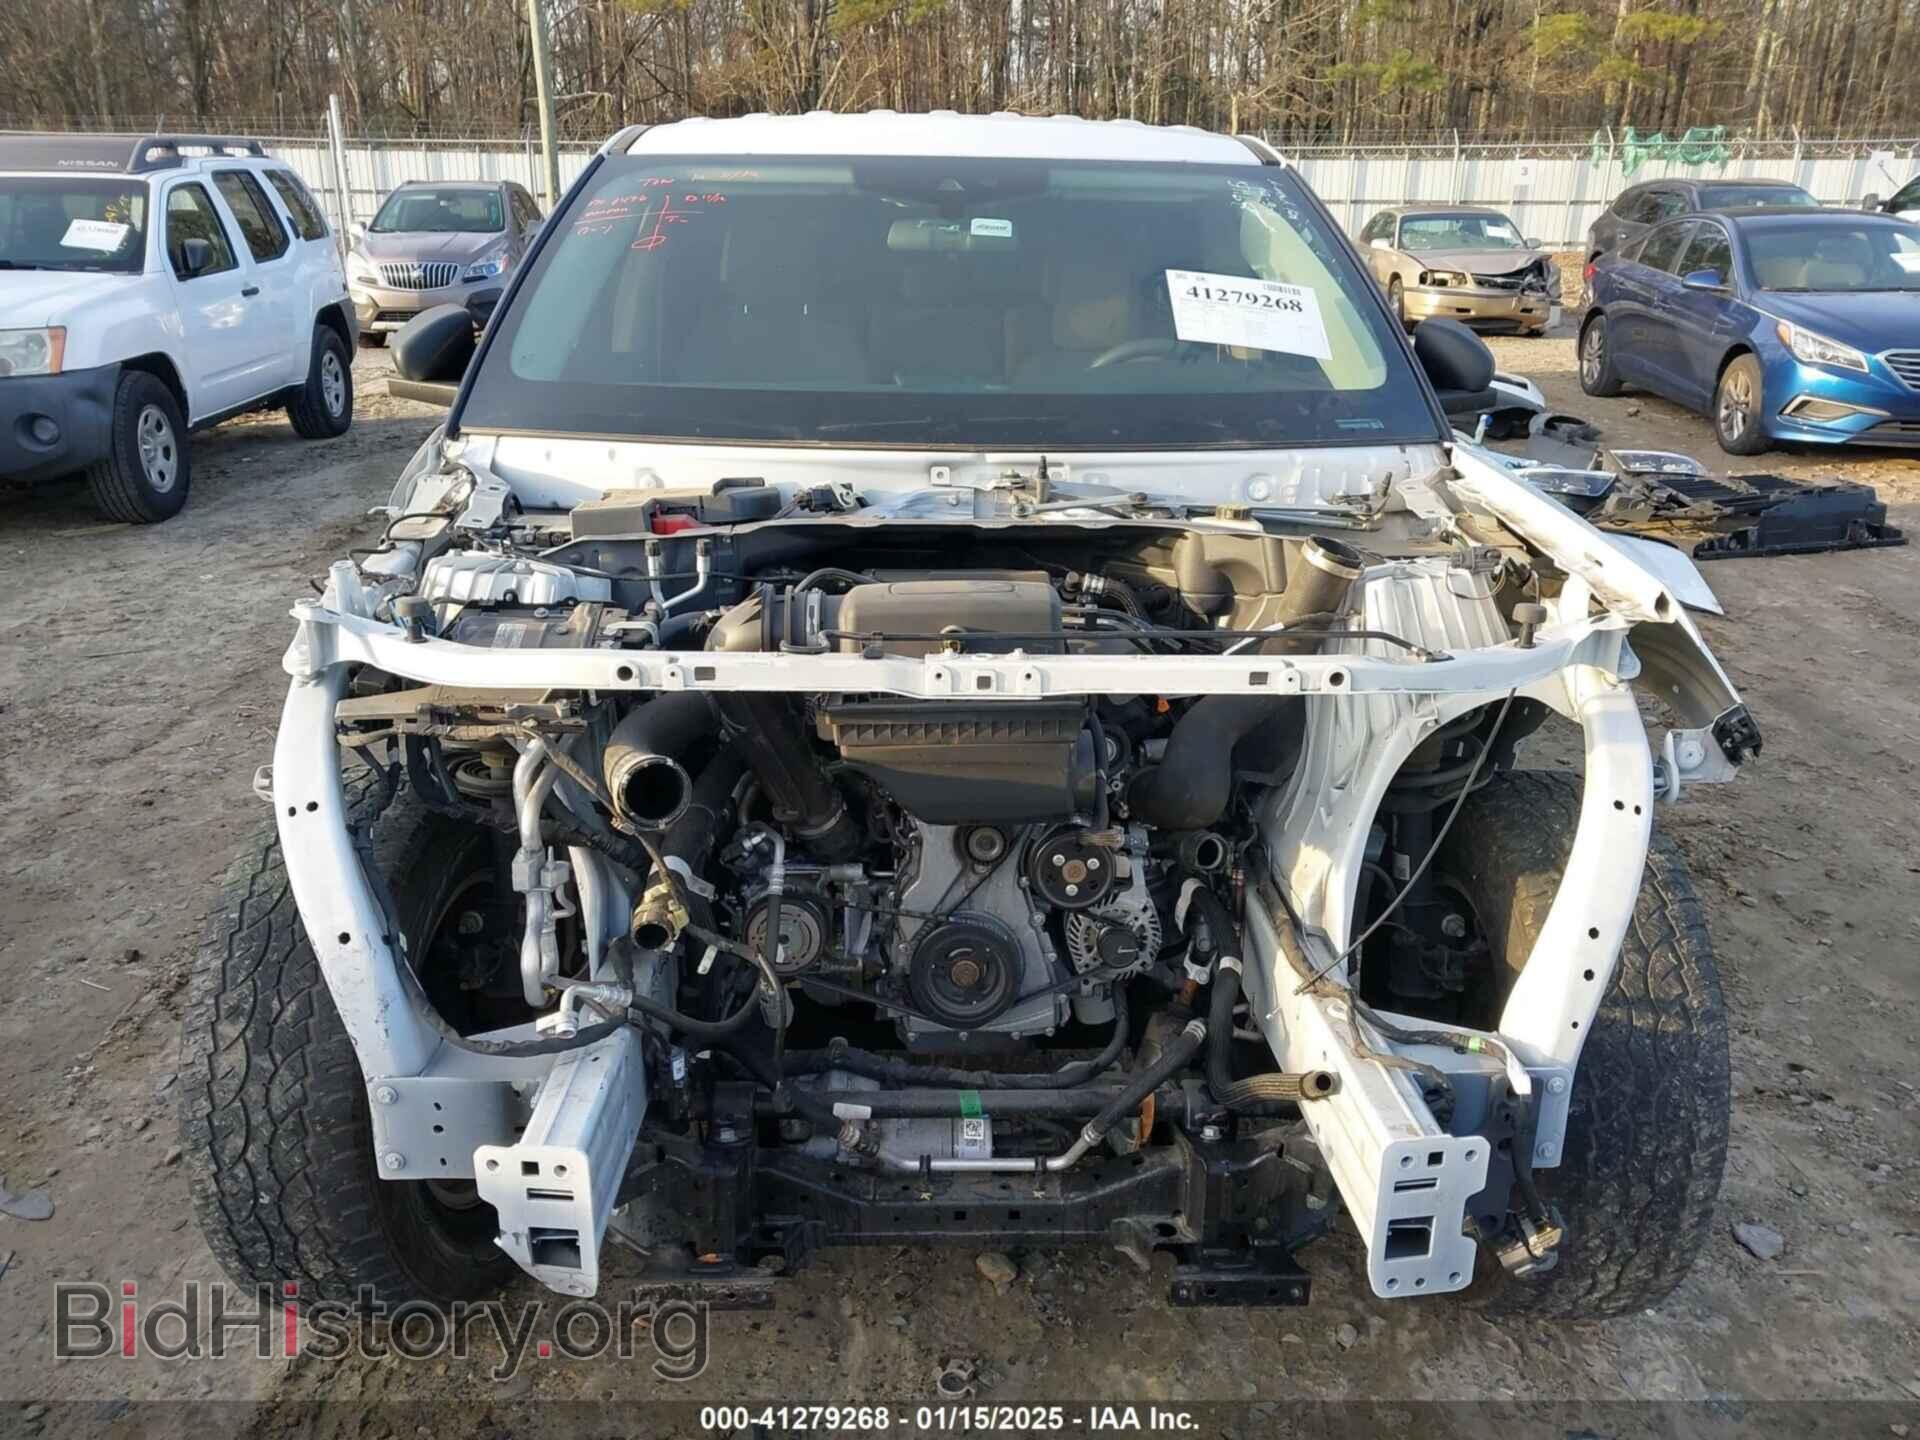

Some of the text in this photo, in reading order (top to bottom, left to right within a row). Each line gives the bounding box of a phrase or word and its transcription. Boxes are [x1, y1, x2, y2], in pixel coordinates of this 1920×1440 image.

[58, 159, 119, 167] NISSAN
[1520, 166, 1528, 176] 3
[1186, 285, 1304, 313] 41279268
